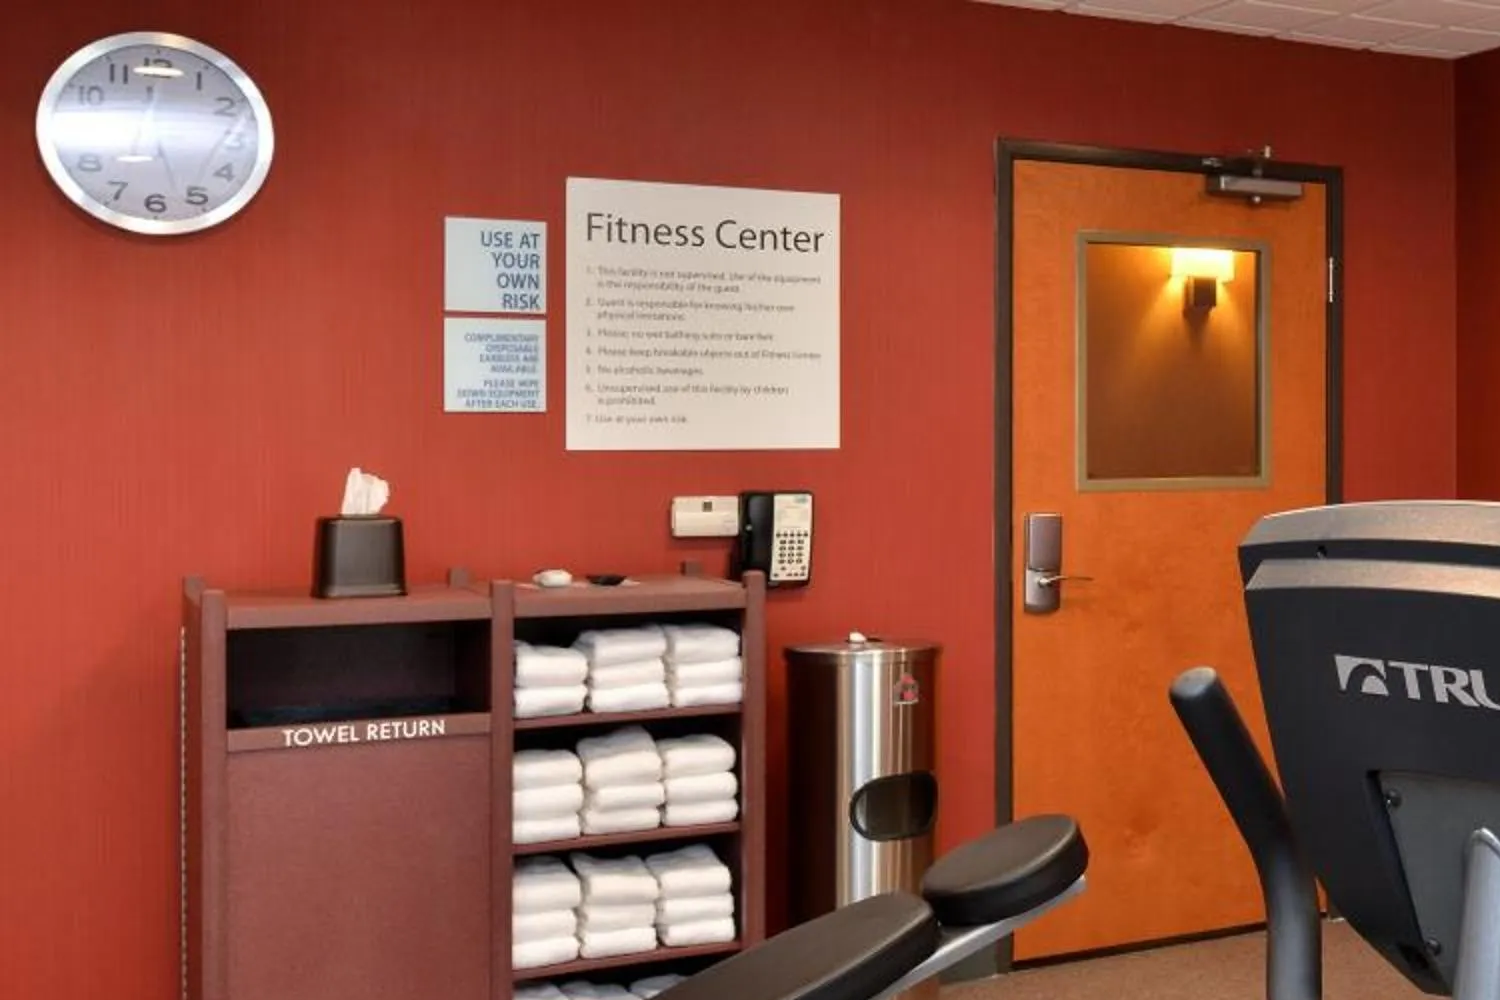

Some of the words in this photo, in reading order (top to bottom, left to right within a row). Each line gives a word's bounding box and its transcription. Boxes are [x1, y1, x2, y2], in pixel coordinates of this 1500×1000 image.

[109, 63, 129, 84] 11
[196, 71, 203, 90] 1
[78, 86, 104, 106] 10
[213, 97, 237, 117] 2
[77, 154, 101, 172] 8
[213, 163, 235, 182] 4
[107, 181, 129, 201] 7
[185, 186, 209, 206] 5
[143, 194, 167, 213] 6
[481, 231, 513, 248] USE
[519, 233, 541, 249] AT
[586, 212, 705, 248] Fitness
[715, 219, 825, 253] Center
[491, 252, 541, 270] YOUR
[496, 273, 541, 290] OWN
[502, 294, 541, 310] RISK
[281, 724, 360, 747] TOWEL
[366, 719, 447, 741] RETURN
